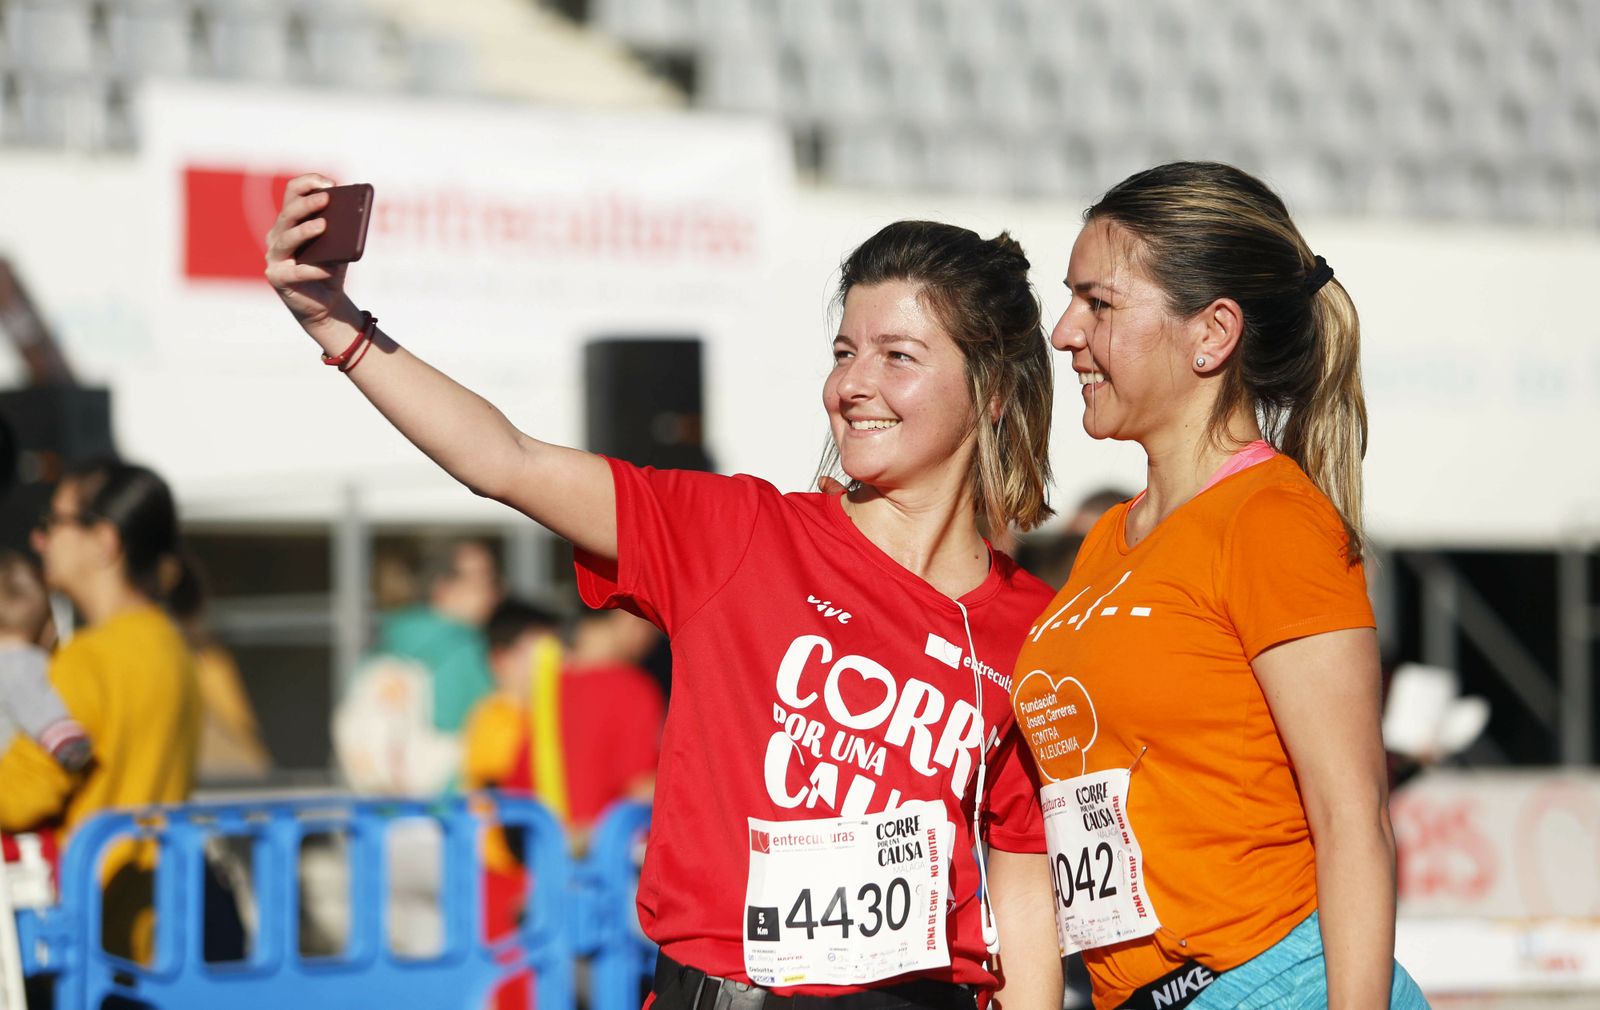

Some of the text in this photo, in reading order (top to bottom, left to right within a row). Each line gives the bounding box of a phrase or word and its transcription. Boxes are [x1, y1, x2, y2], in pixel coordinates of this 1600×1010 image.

[807, 594, 852, 624] vive
[1020, 693, 1057, 716] Fundación
[1026, 704, 1078, 729] Josep Carreras
[773, 702, 887, 776] POR UNA
[1031, 726, 1060, 746] CONTRA
[1043, 736, 1080, 760] LEUCEMIA
[1076, 782, 1109, 805] CORRE
[1082, 808, 1115, 832] CAUSA
[1112, 795, 1125, 829] QUITAR
[876, 815, 921, 840] CORRE
[1122, 832, 1131, 845] NO
[877, 840, 889, 848] POR
[878, 841, 923, 867] CAUSA
[927, 828, 939, 862] QUITAR
[930, 864, 939, 878] NO
[1129, 856, 1137, 879] CHIP
[1131, 880, 1138, 893] DE
[785, 877, 911, 940] 4430
[930, 889, 938, 912] CHIP
[1133, 894, 1147, 918] ZONA
[758, 912, 766, 924] 5
[928, 914, 936, 926] DE
[757, 927, 768, 935] Km
[926, 926, 936, 951] ZONA
[1151, 965, 1214, 1010] NIKE
